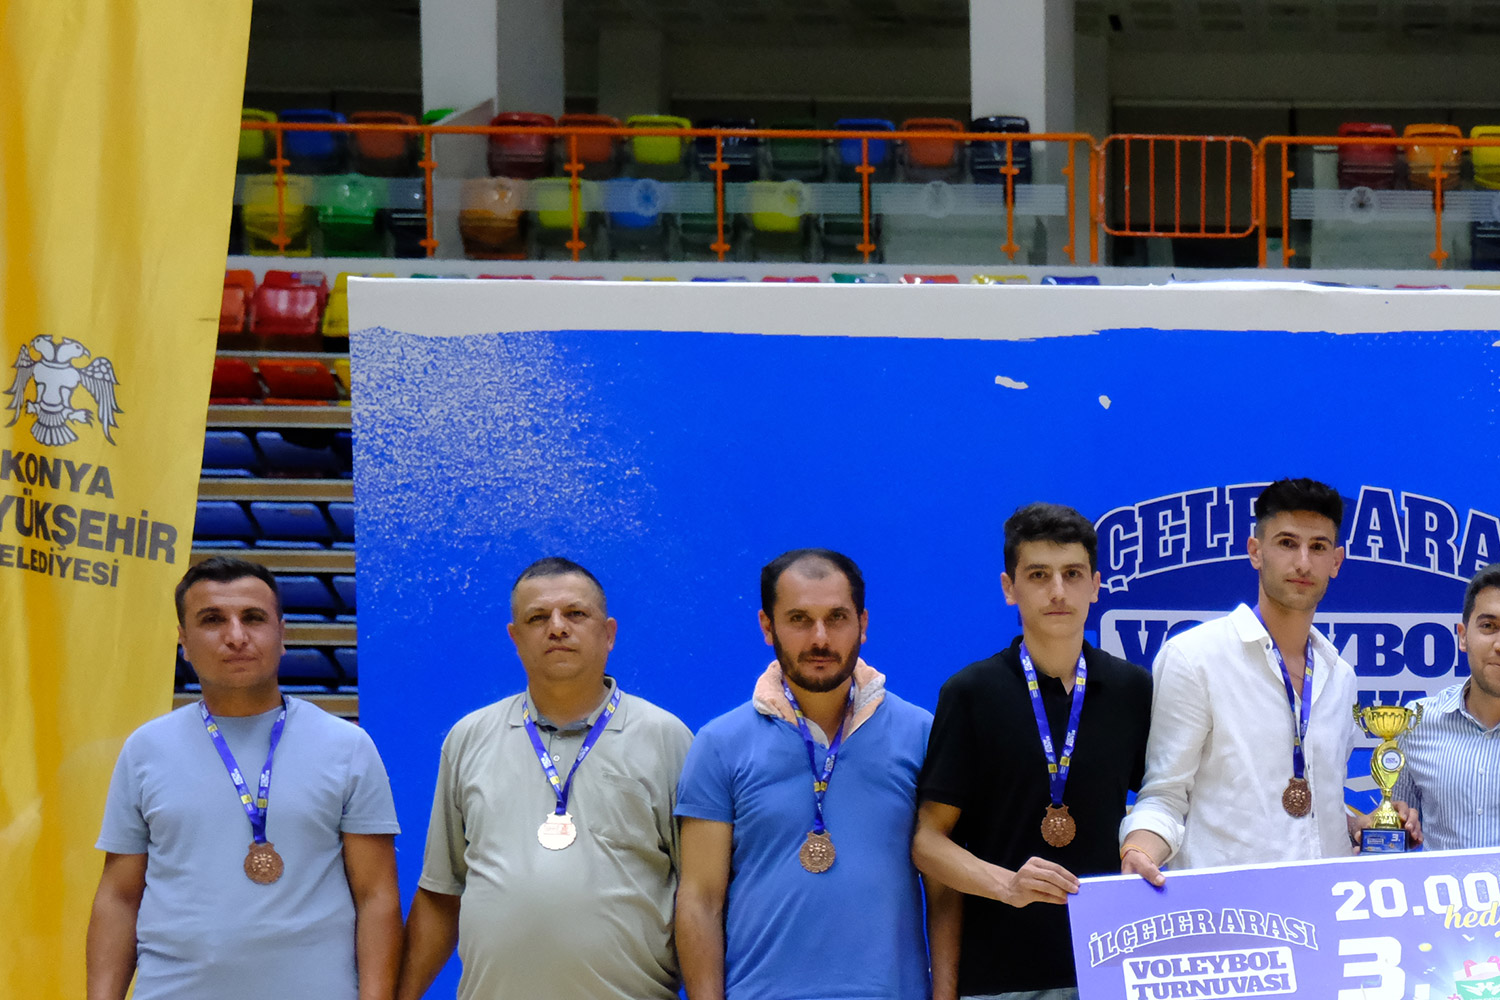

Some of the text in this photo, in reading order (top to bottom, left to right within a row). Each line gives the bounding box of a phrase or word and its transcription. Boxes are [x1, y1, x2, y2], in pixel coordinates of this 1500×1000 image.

[0, 449, 114, 499] KONYA
[1088, 908, 1319, 968] İLÇELER ARASI
[1129, 950, 1287, 979] VOLEYBOL
[1132, 973, 1291, 1000] TURNUVASI
